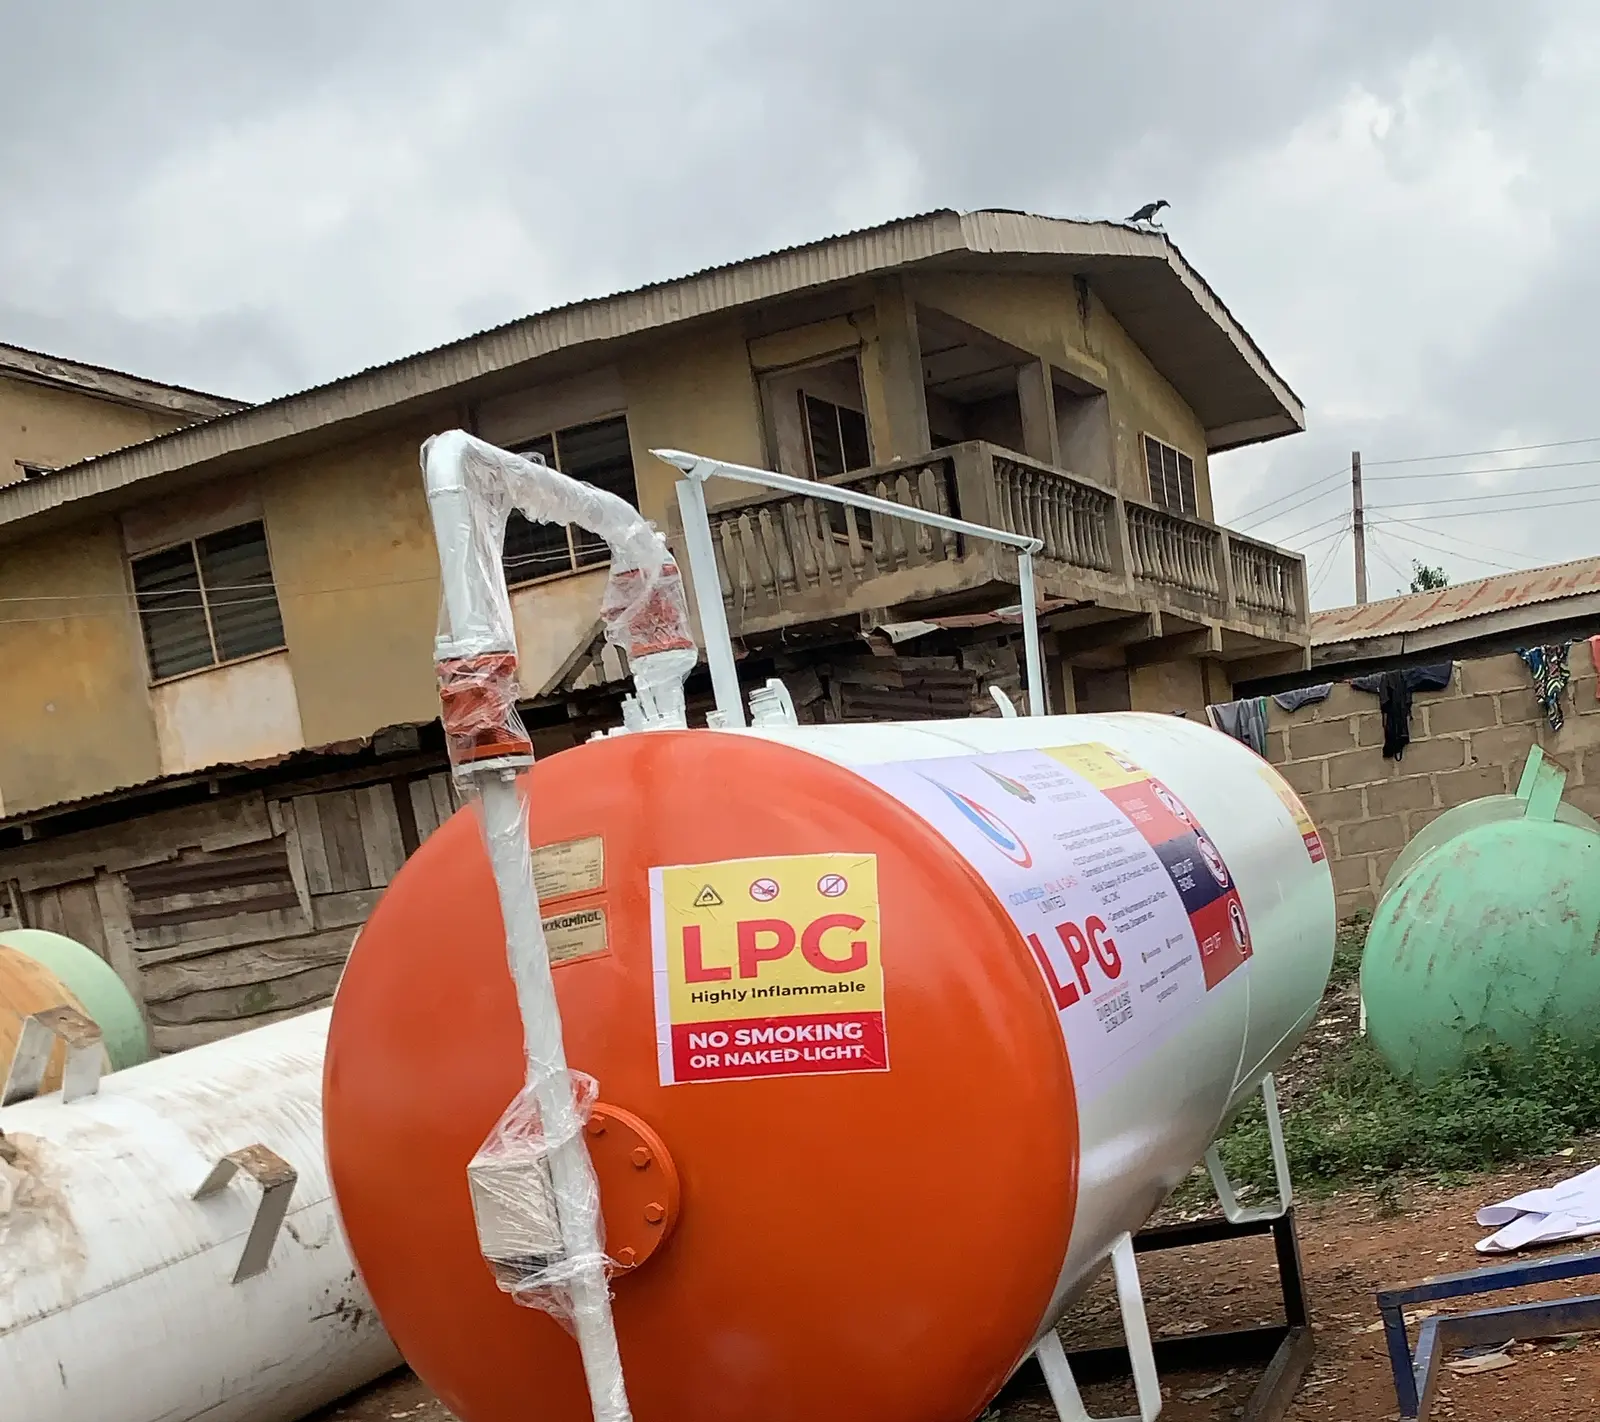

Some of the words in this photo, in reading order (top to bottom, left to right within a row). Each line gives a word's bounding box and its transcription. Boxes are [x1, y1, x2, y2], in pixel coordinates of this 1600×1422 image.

[683, 914, 867, 983] LPG
[1027, 915, 1122, 1011] LPG
[691, 988, 747, 1004] Highly
[752, 981, 866, 998] Inflammable
[689, 1031, 729, 1049] NO
[734, 1022, 864, 1046] SMOKING
[690, 1055, 720, 1069] OR
[724, 1049, 800, 1065] NAKED
[803, 1045, 865, 1061] LIGHT
